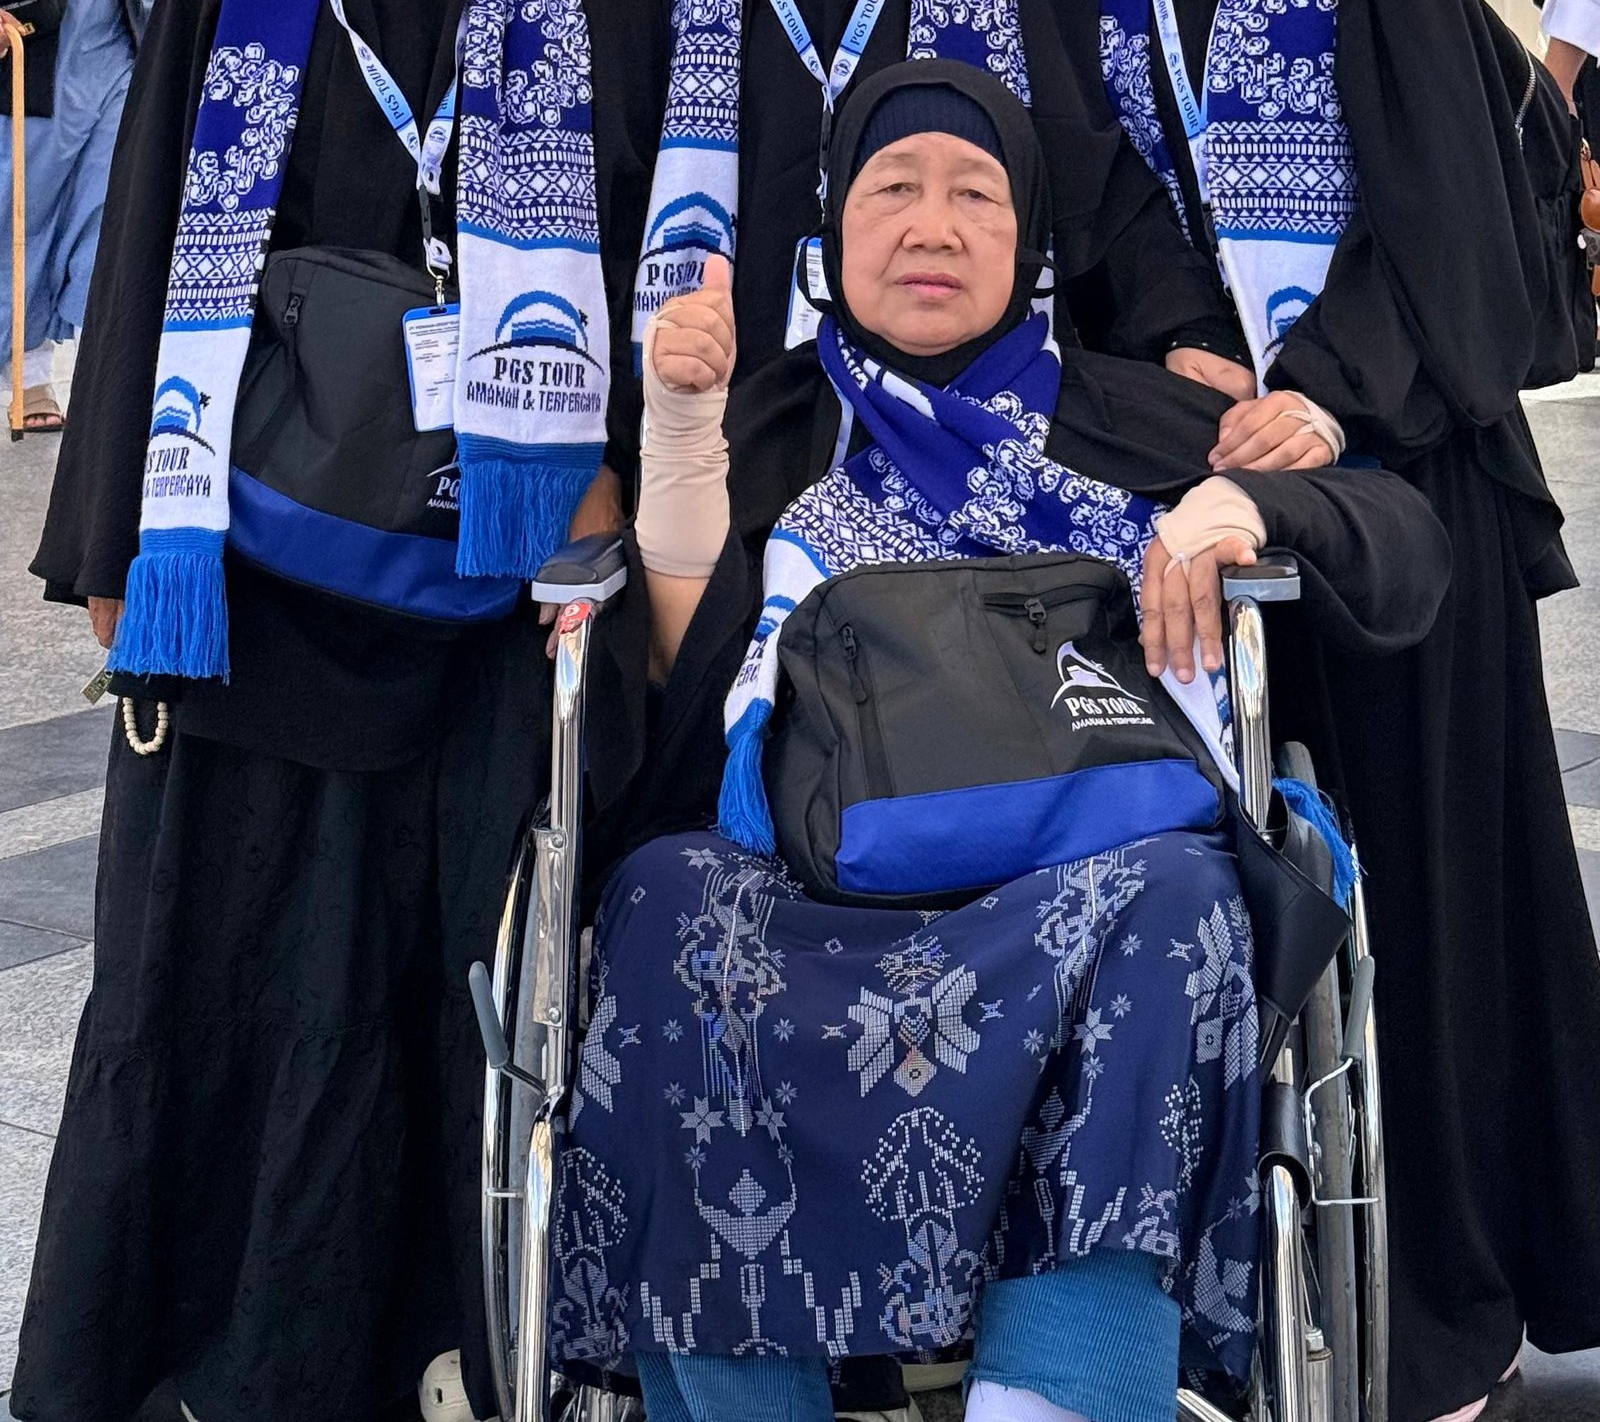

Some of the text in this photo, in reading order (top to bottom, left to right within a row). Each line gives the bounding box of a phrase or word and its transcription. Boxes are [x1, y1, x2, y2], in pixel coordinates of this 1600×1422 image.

[782, 9, 804, 45] TOUR
[850, 21, 869, 46] PGS
[366, 64, 403, 120] PGS TOUR
[1175, 68, 1198, 129] PGS TOUR
[493, 357, 586, 389] PGS TOUR
[467, 380, 519, 410] AMANAH
[522, 390, 535, 411] &
[539, 390, 601, 414] TERPERCAYA
[155, 446, 190, 473] TOUR
[1064, 696, 1145, 717] PGS TOUR
